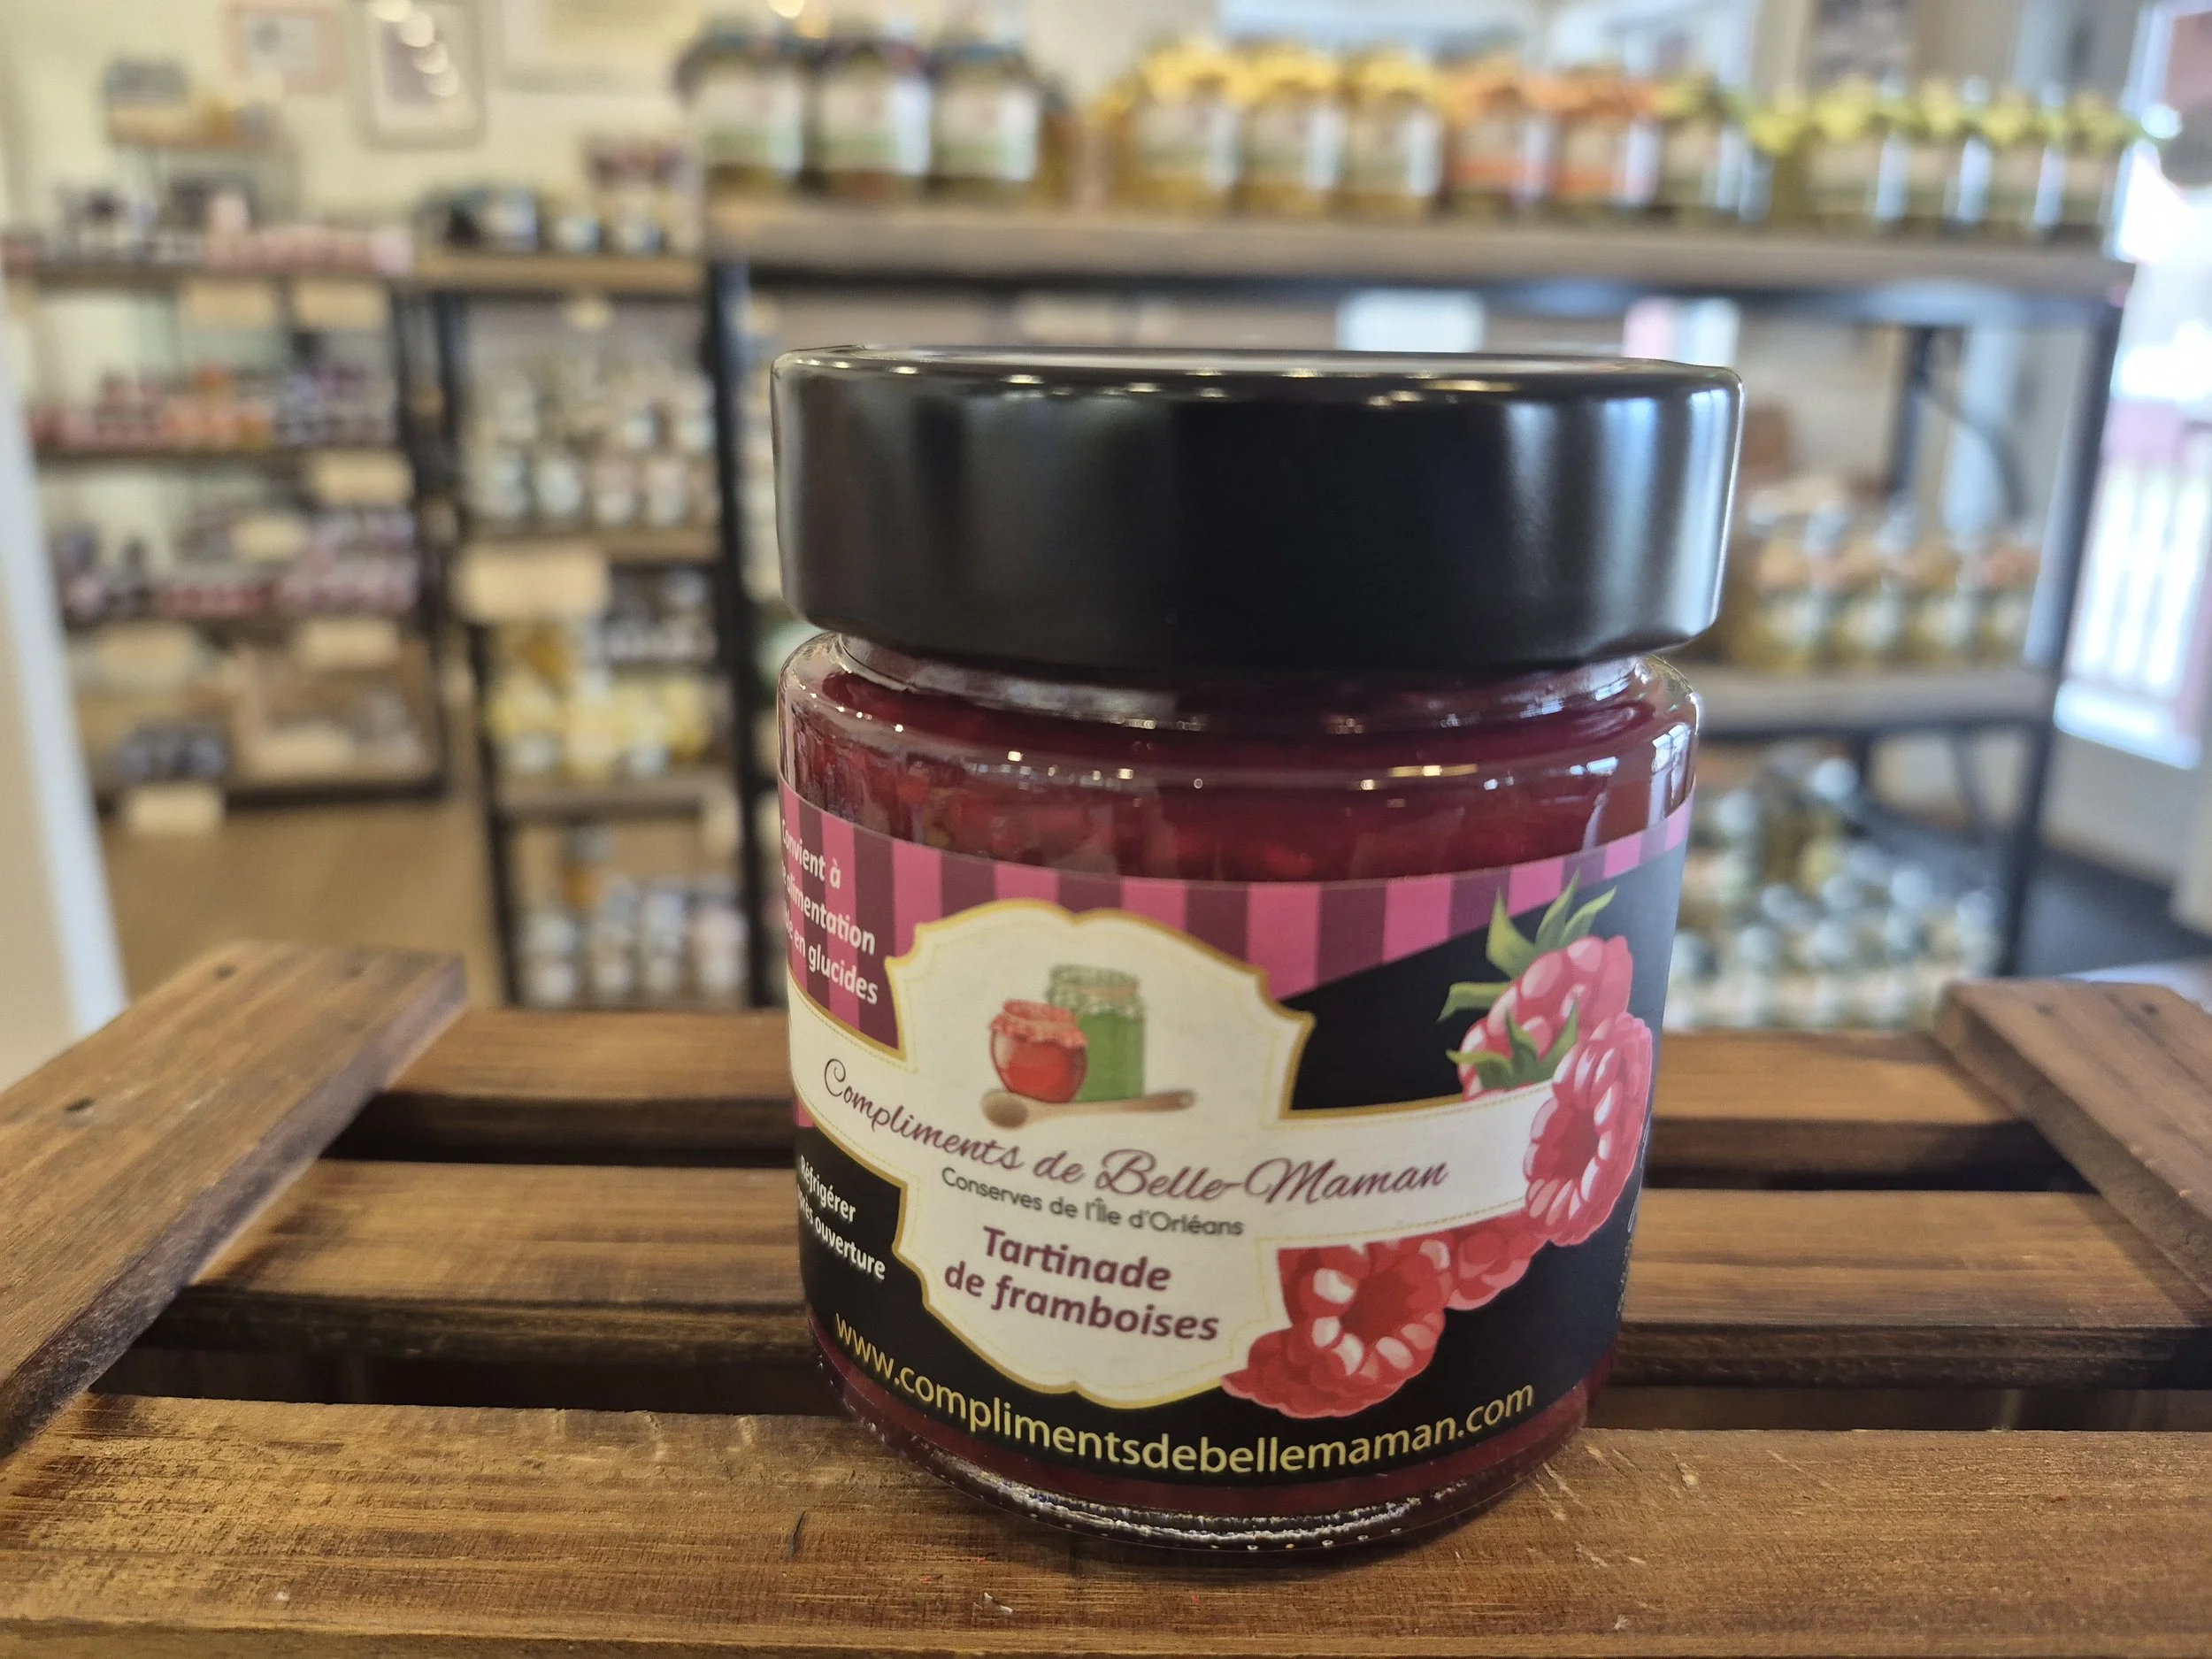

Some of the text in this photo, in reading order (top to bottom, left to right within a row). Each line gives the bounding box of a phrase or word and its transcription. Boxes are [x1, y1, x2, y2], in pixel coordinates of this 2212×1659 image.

[781, 818, 826, 881] Convient
[829, 856, 841, 890] à
[787, 872, 876, 956] alimentation
[794, 929, 806, 957] en
[809, 944, 879, 1005] glucides
[824, 1058, 1449, 1205] Compliments de Belle-Maman
[801, 1154, 856, 1222] Réfrigérer
[941, 1166, 1042, 1211] Conserves
[1048, 1196, 1078, 1218] de
[1128, 1210, 1245, 1236] d'Orléans
[814, 1216, 886, 1280] ouverture
[983, 1225, 1171, 1292] Tartinade
[944, 1261, 1220, 1341] de framboises
[835, 1311, 1535, 1475] www.complimentsdebellemaman.com
